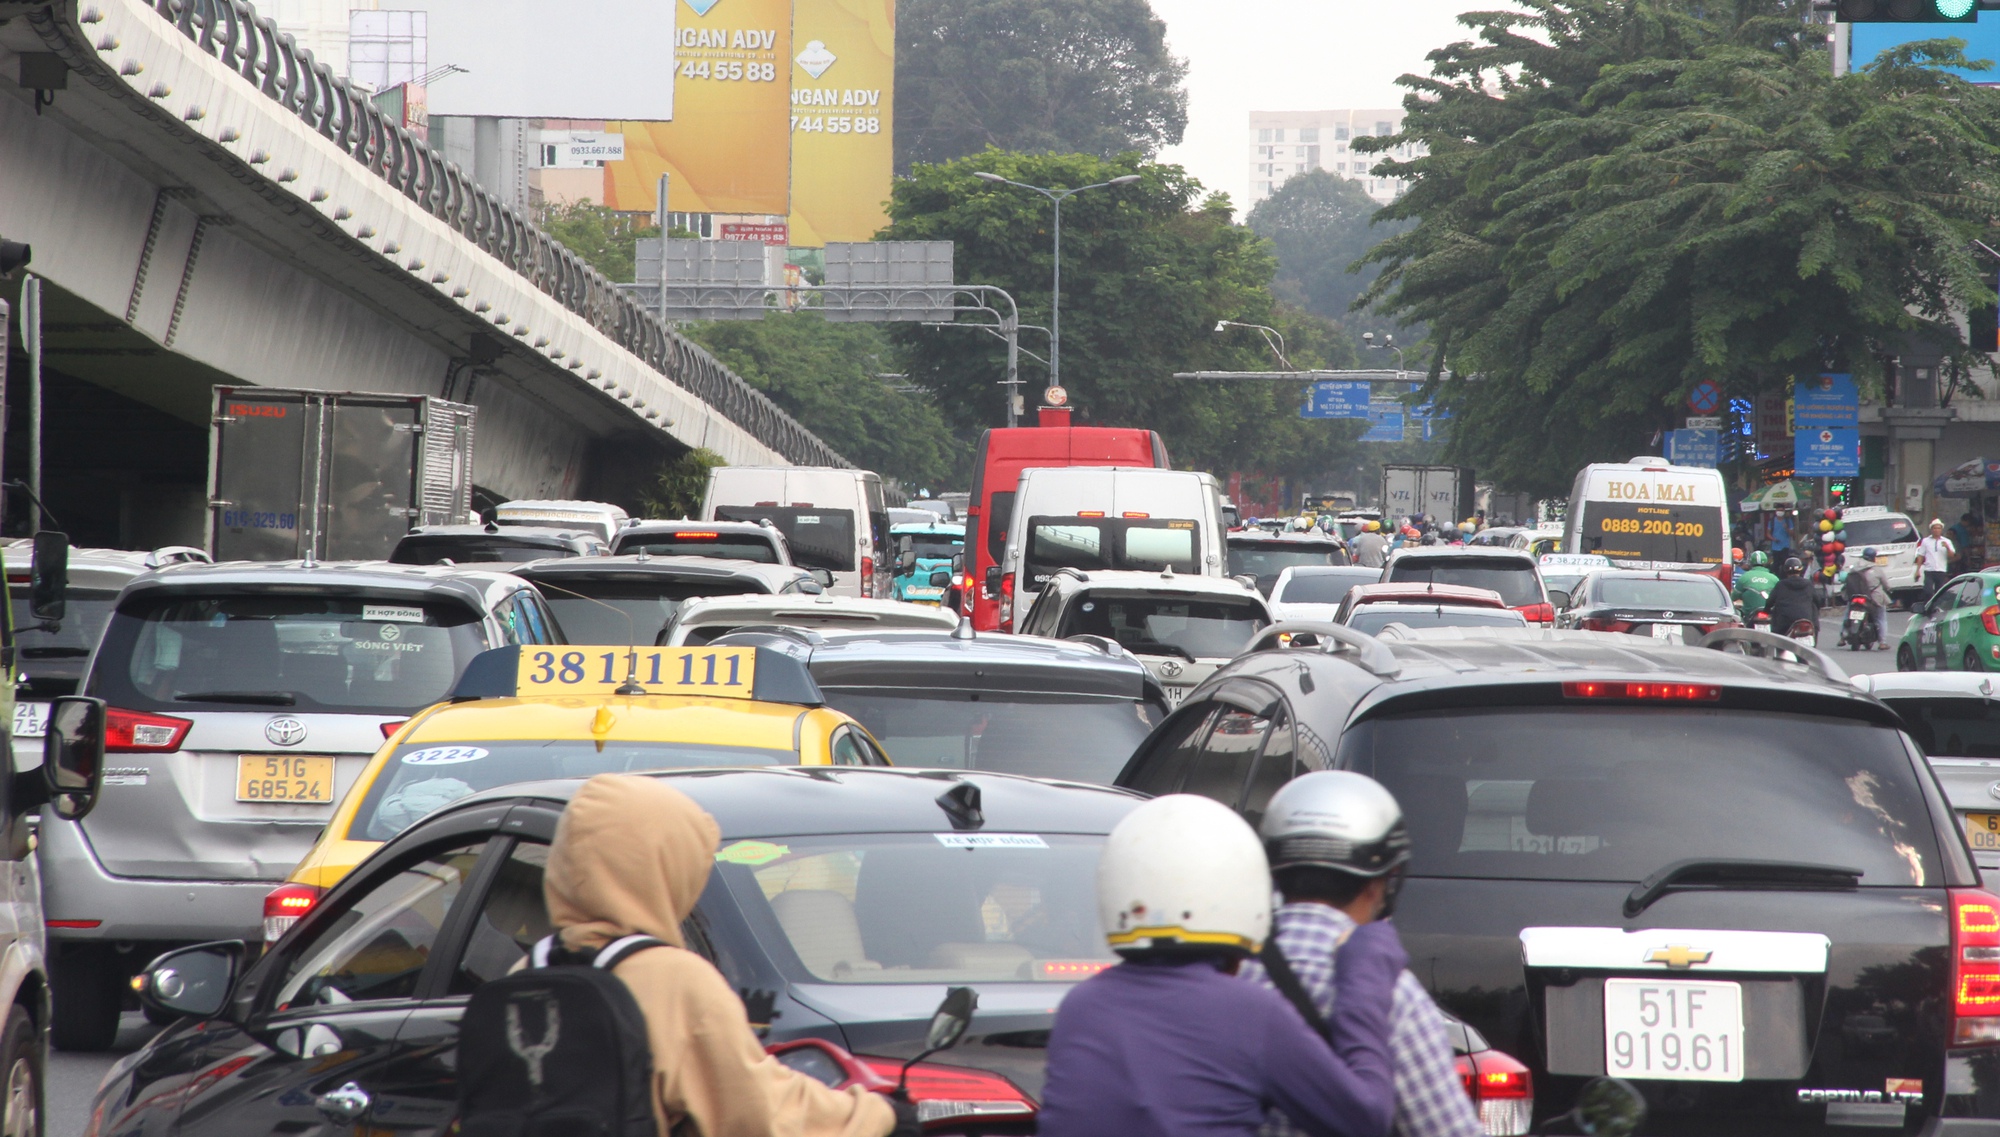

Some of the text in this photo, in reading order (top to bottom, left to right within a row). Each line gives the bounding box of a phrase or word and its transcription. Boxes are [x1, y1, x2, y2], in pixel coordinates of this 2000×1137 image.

[731, 30, 775, 49] ADV
[714, 62, 743, 80] 55
[746, 62, 775, 81] 88
[842, 89, 880, 106] ADV
[827, 117, 851, 133] 55
[854, 117, 880, 134] 88
[229, 403, 287, 419] ISUZU
[1608, 481, 1695, 502] HOA MAI
[224, 510, 295, 529] 61C-329.60
[1637, 507, 1670, 515] HOTLINE
[1601, 518, 1704, 537] 0889.200.200
[1584, 558, 1594, 566] 27
[1596, 558, 1606, 566] 27
[1751, 576, 1769, 584] Grab
[530, 651, 744, 686] 38 111 111
[1163, 687, 1182, 699] 1H
[17, 704, 37, 717] 2A
[409, 747, 477, 763] 3224
[265, 757, 306, 778] 51G
[247, 779, 321, 799] 685.24
[1975, 832, 2000, 847] 08
[1639, 988, 1707, 1029] 51F
[1614, 1030, 1729, 1073] 919.61
[1797, 1089, 1923, 1105] CAPTIVA LTZ
